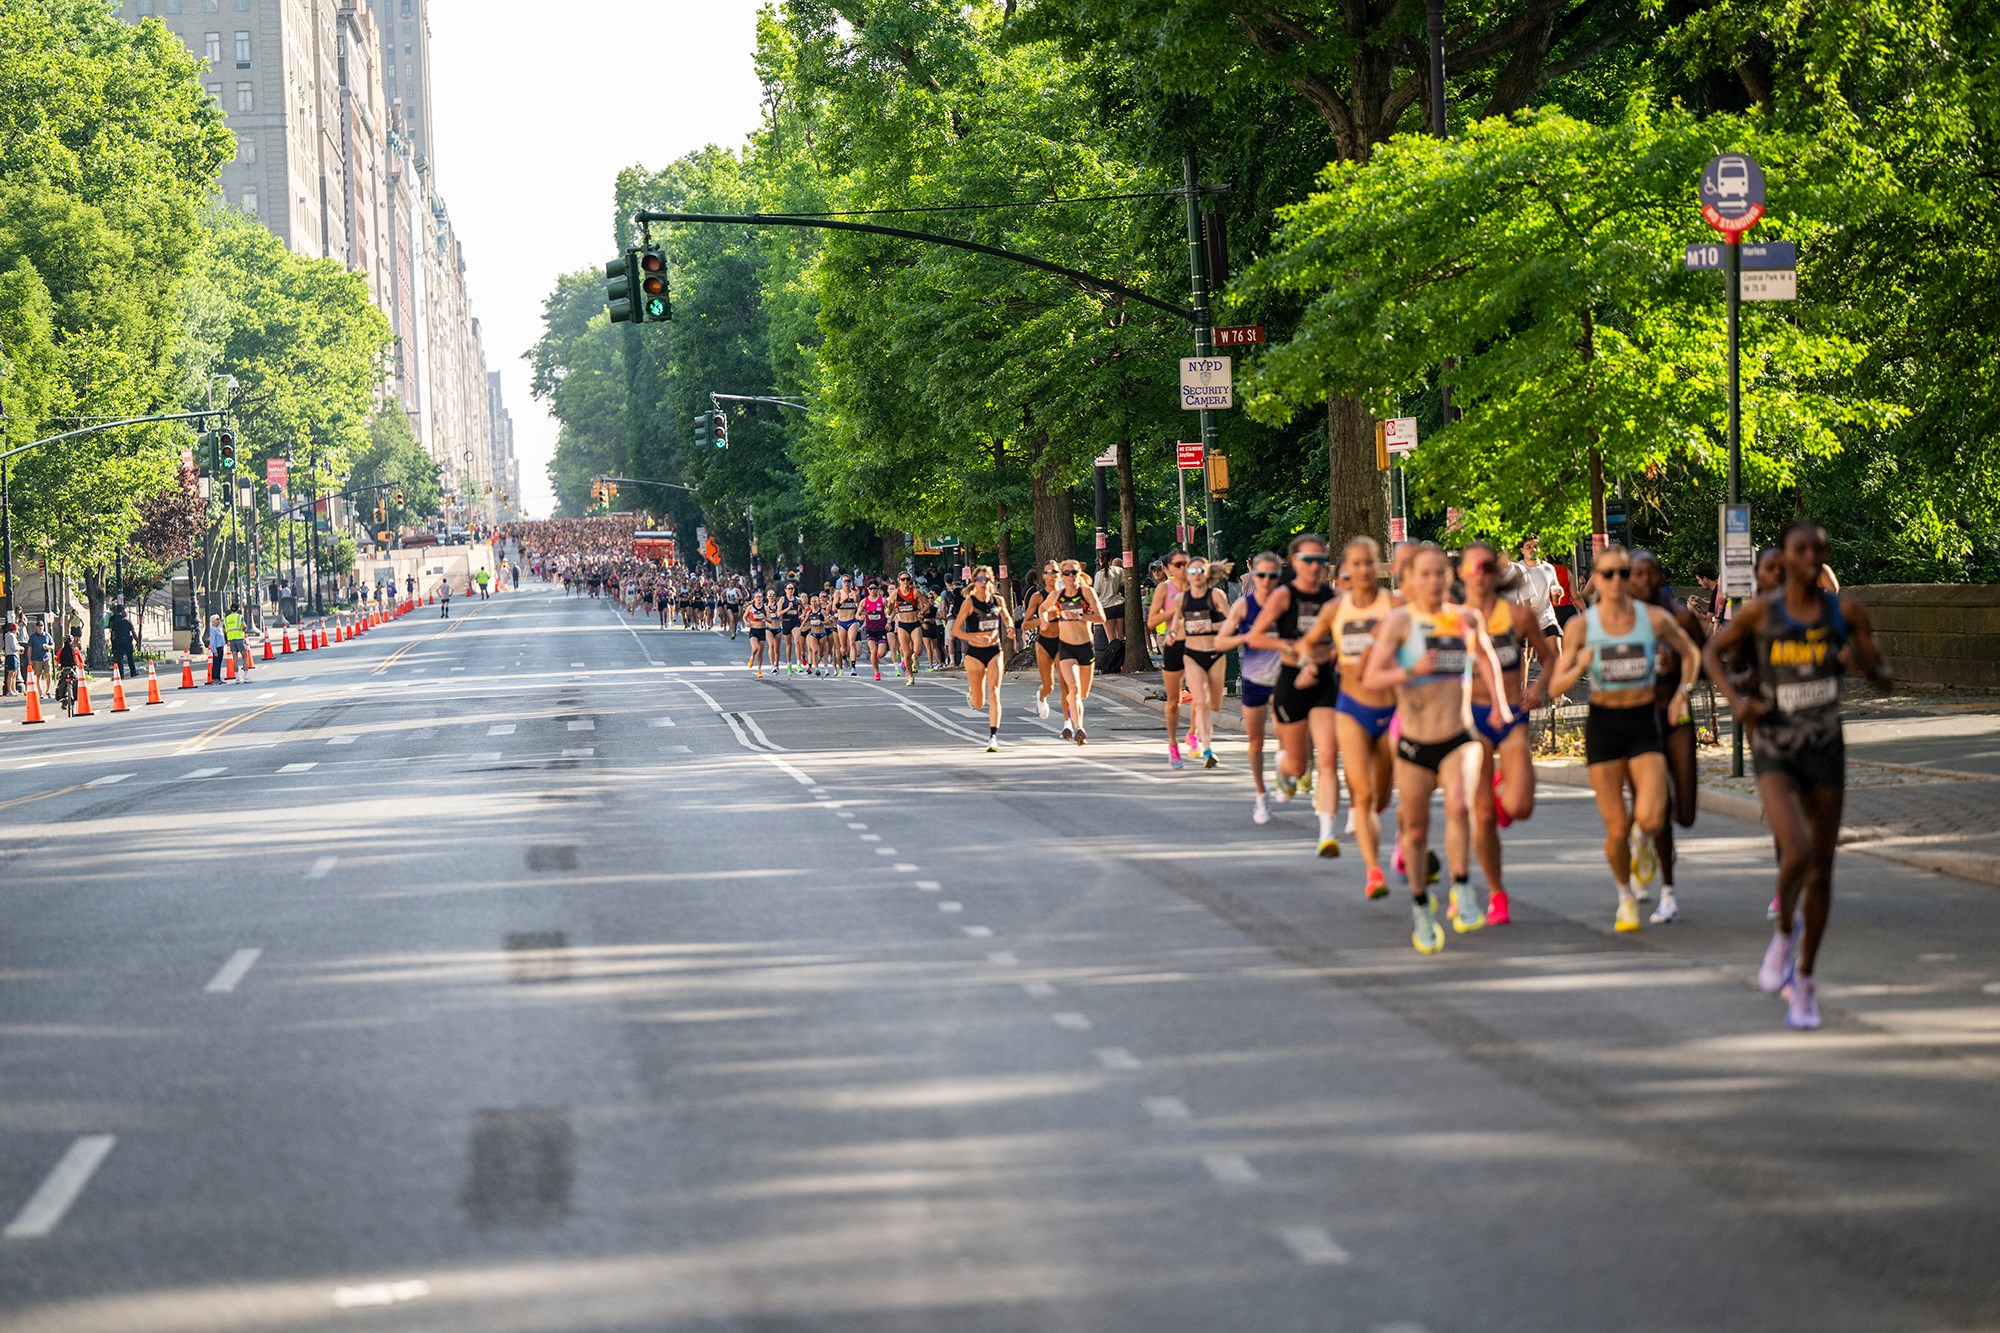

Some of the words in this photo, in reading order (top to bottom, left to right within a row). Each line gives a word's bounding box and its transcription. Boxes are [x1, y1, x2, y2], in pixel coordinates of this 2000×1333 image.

[1705, 207, 1719, 223] NO
[1719, 206, 1760, 231] STANDING
[1687, 247, 1718, 266] M10
[1220, 331, 1229, 343] W
[1232, 330, 1244, 342] 76
[1247, 329, 1257, 341] St
[1188, 361, 1223, 372] NYPD
